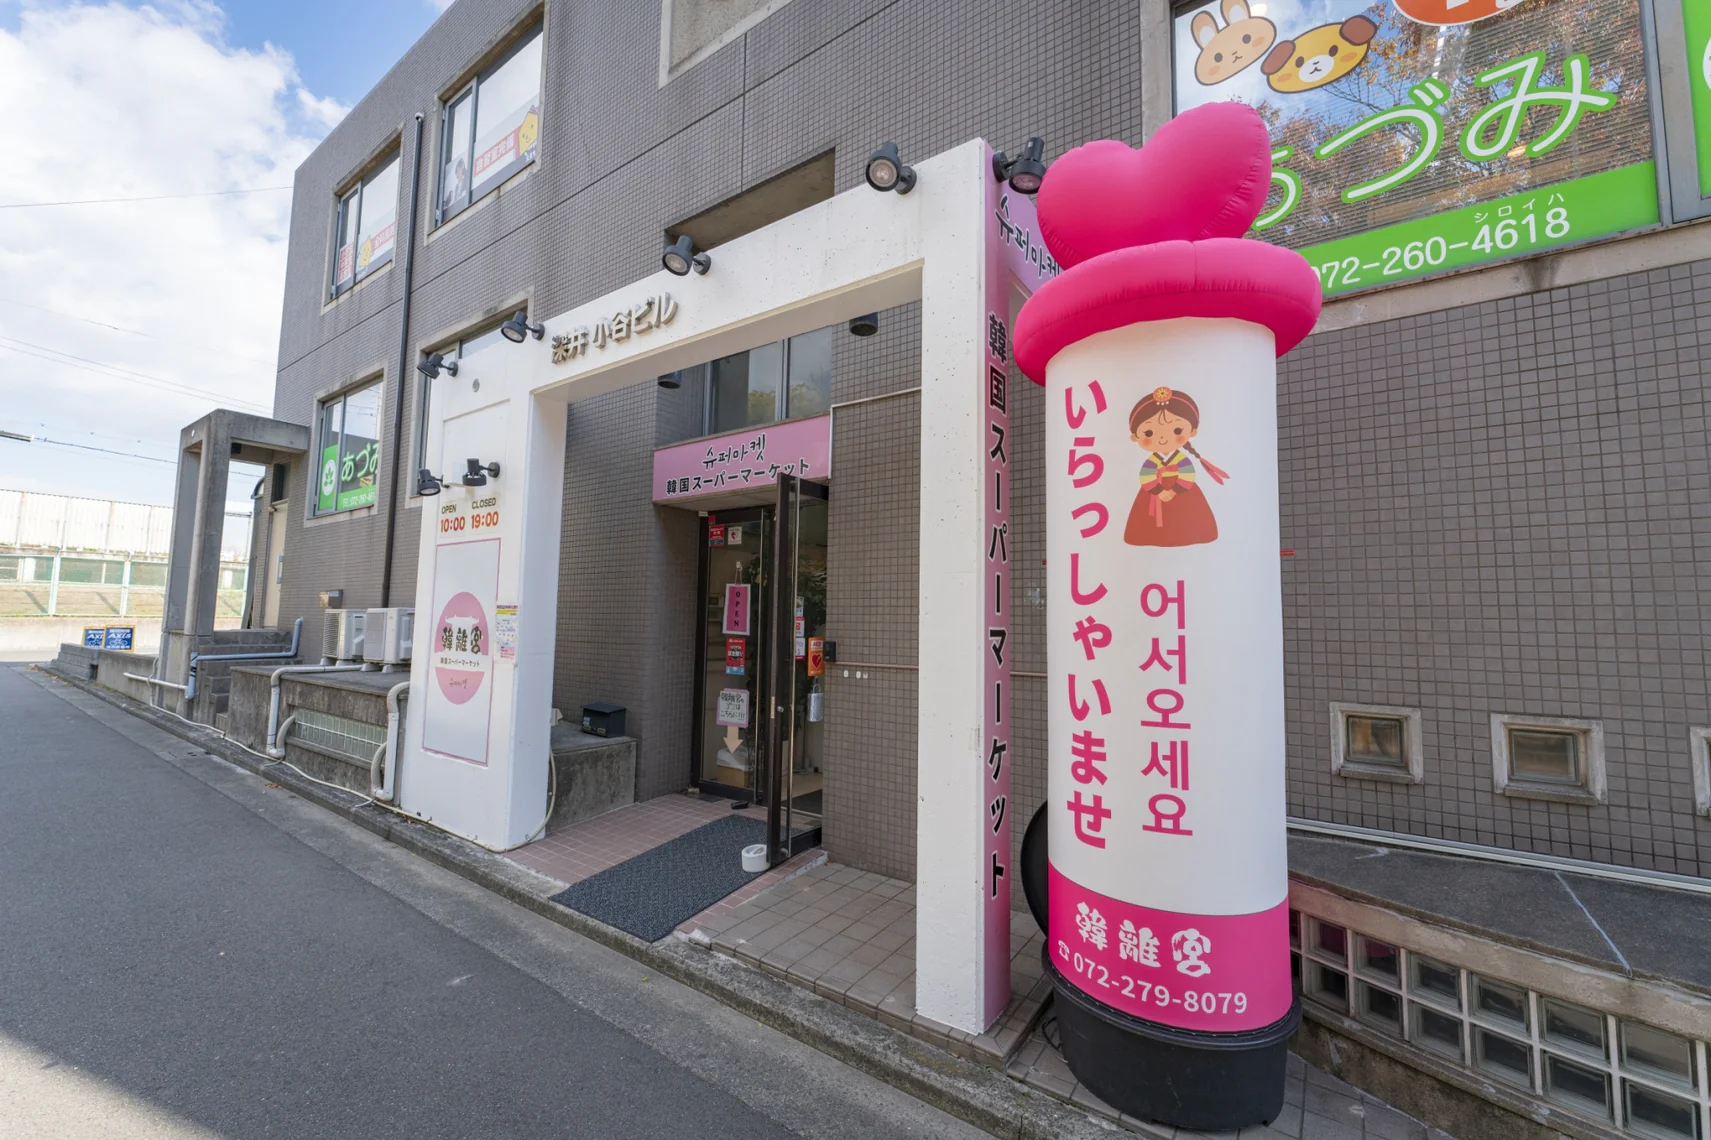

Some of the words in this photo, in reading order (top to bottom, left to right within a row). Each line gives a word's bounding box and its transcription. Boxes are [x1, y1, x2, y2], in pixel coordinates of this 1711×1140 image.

[1474, 193, 1564, 223] シロイハ
[703, 433, 767, 470] 슈퍼마켓
[666, 458, 809, 495] 韓国スーパーマーケット
[440, 516, 465, 532] 10:00
[471, 511, 499, 529] 19:00
[441, 504, 457, 514] OPEN
[471, 497, 497, 509] CLOSED
[988, 313, 1009, 899] 韓国スーパーマーケット
[1065, 380, 1112, 849] いらっしゃいませ
[1139, 580, 1193, 836] 어서오세요
[1073, 952, 1248, 1014] 072-279-8079
